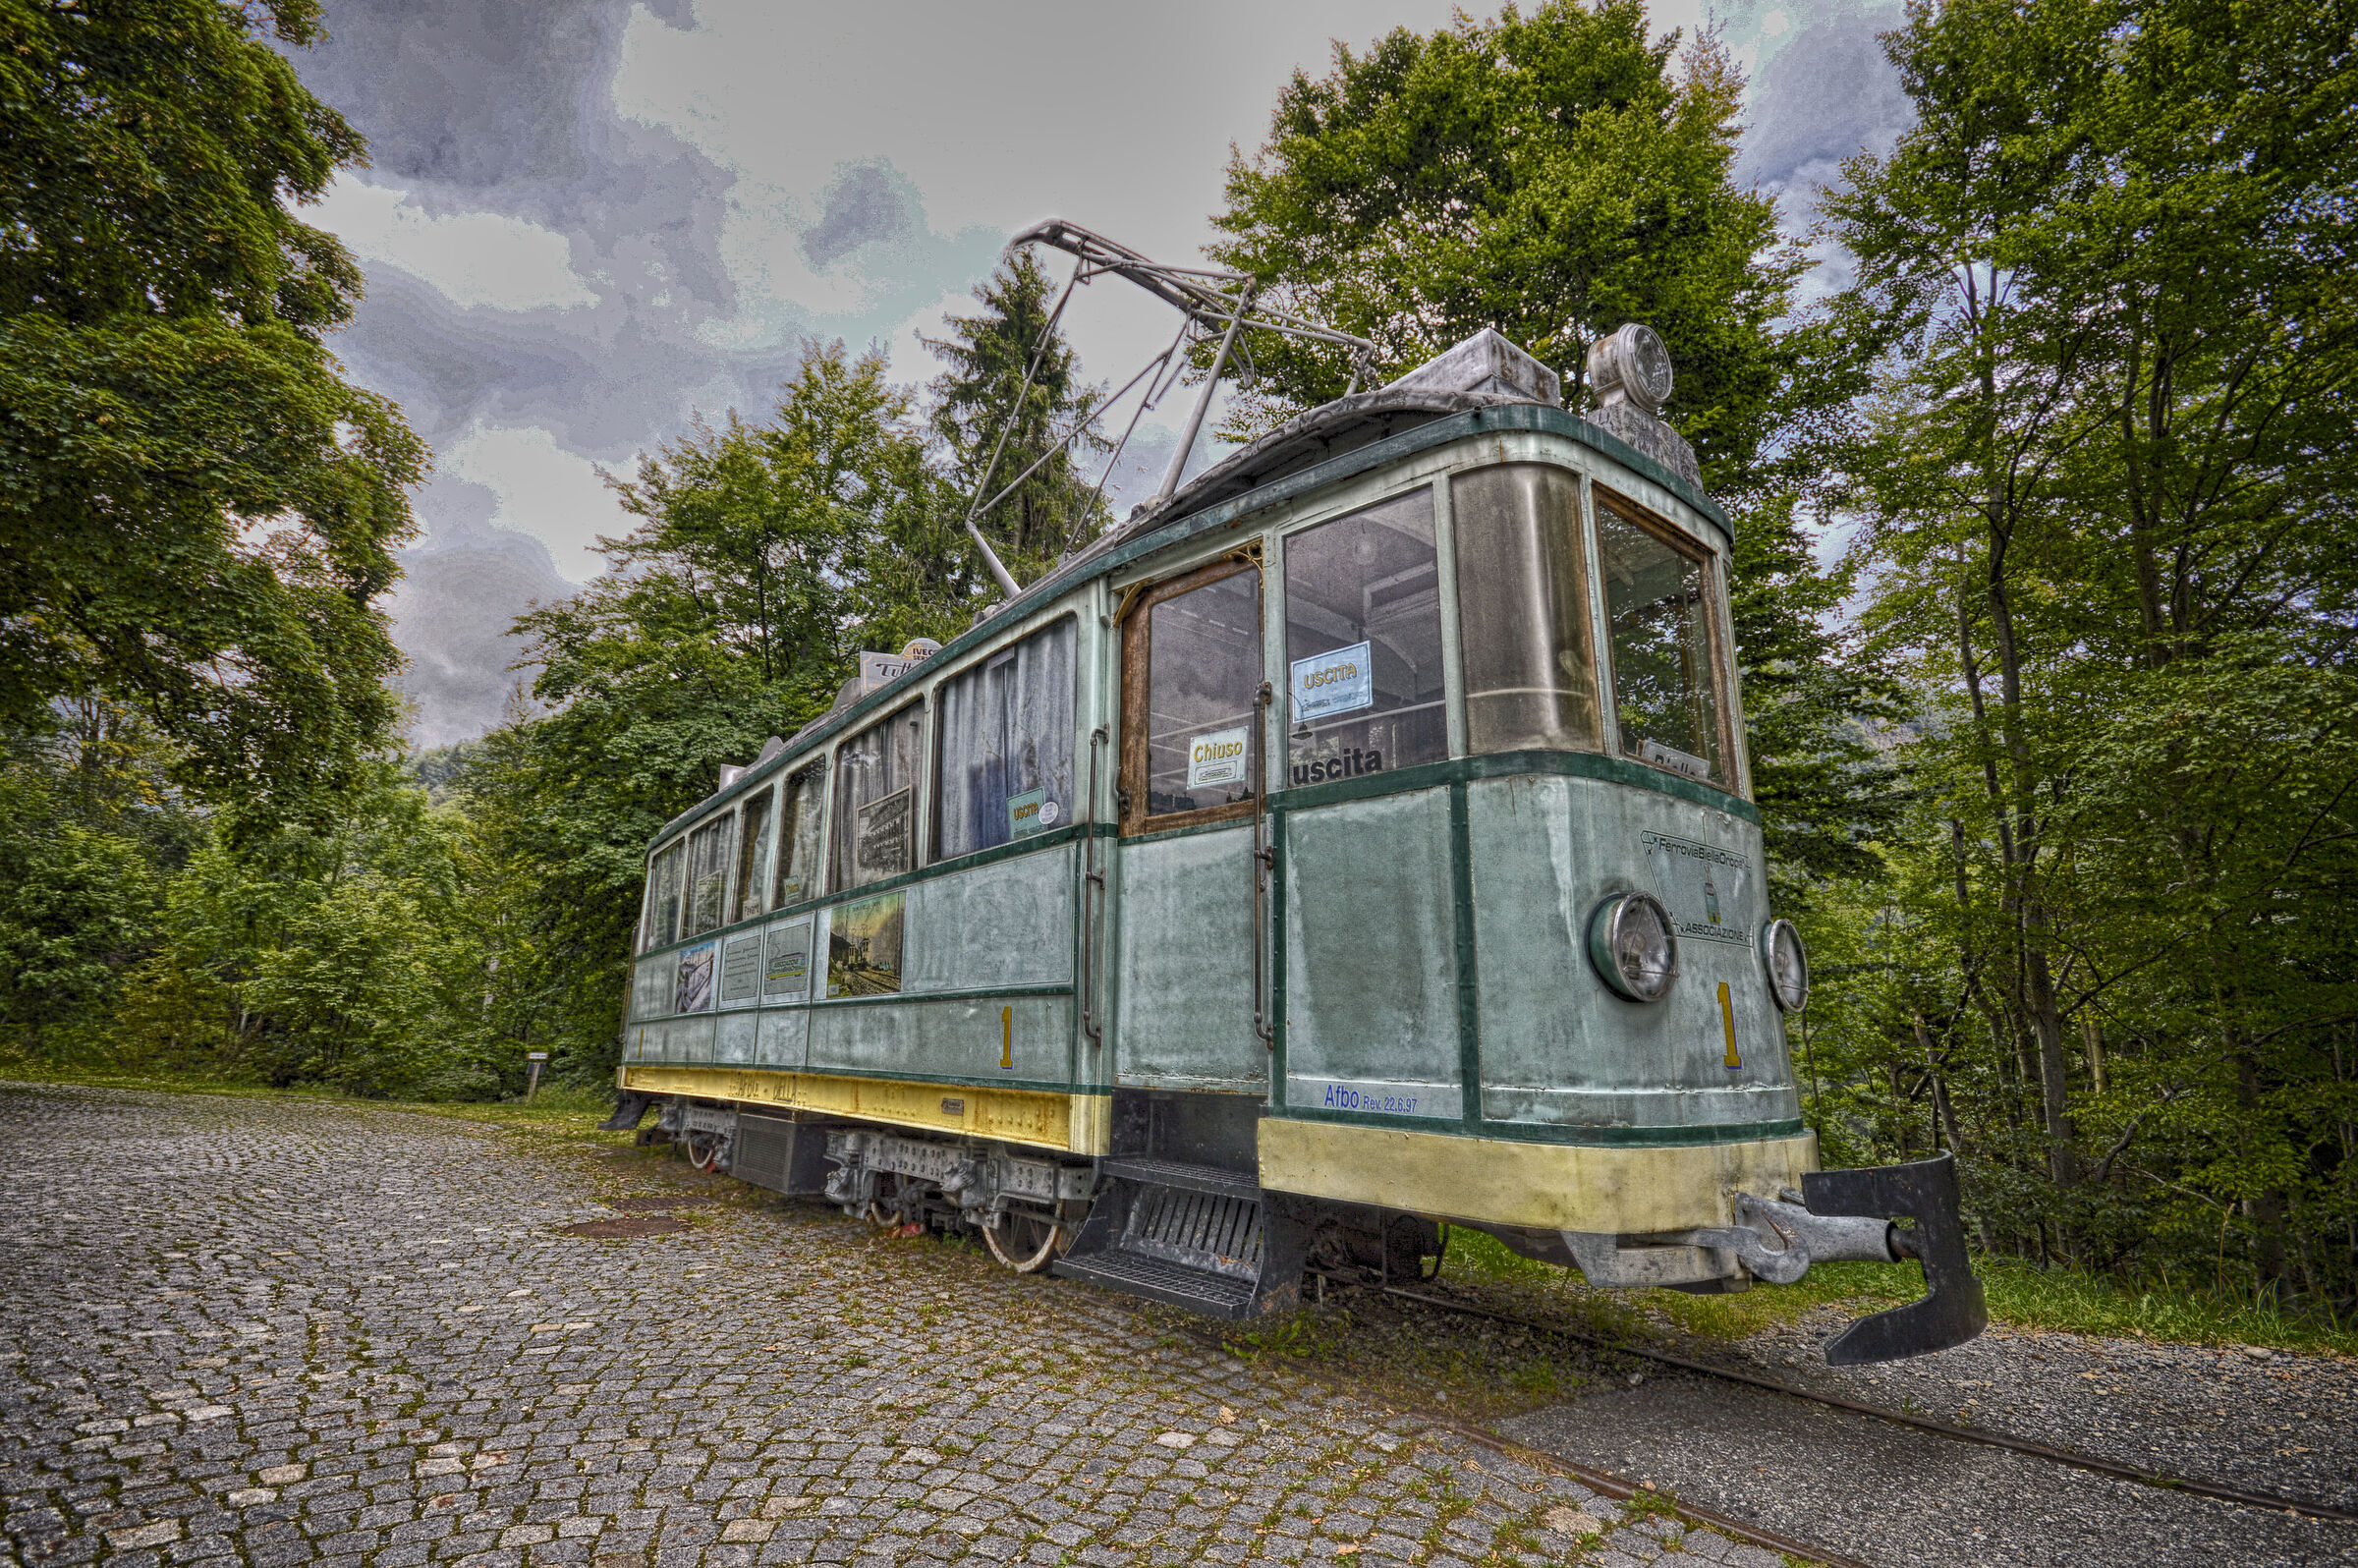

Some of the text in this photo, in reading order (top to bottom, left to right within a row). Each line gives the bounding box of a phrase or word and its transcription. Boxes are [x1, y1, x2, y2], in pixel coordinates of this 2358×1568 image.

[1304, 662, 1358, 690] USCITA
[1194, 741, 1243, 763] Chiuso
[1293, 748, 1382, 784] uscita
[1685, 923, 1744, 942] ASSOCIAZIONE
[999, 1005, 1014, 1070] 1
[1716, 981, 1743, 1070] 1
[1323, 1084, 1418, 1114] Afbo Rev. 22.6.97
